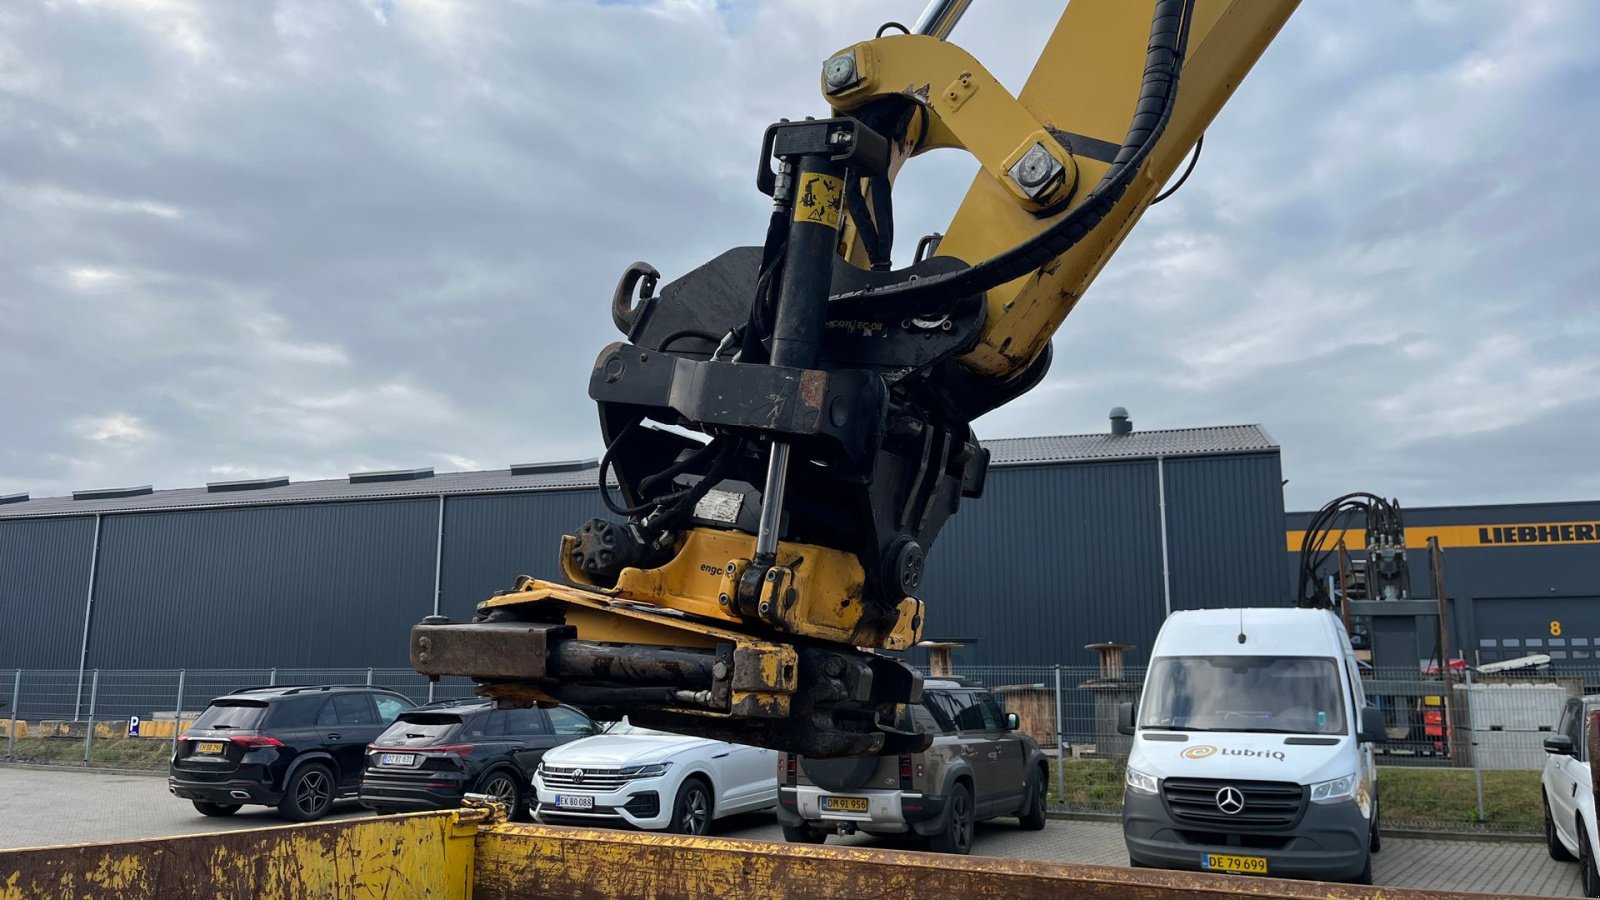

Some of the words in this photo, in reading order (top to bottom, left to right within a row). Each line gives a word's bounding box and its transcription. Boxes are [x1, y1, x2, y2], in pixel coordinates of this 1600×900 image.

[1479, 524, 1600, 543] LIEBHER
[700, 564, 725, 575] engc
[1550, 620, 1561, 636] 8
[130, 716, 139, 731] P
[1221, 748, 1286, 762] LubriQ
[560, 797, 569, 805] EK
[569, 797, 578, 806] 80
[579, 798, 592, 806] 088
[828, 798, 839, 808] DM
[840, 799, 849, 809] 91
[851, 800, 866, 809] 956
[1209, 856, 1224, 868] DE
[1227, 857, 1241, 869] 79
[1243, 858, 1265, 871] 699
